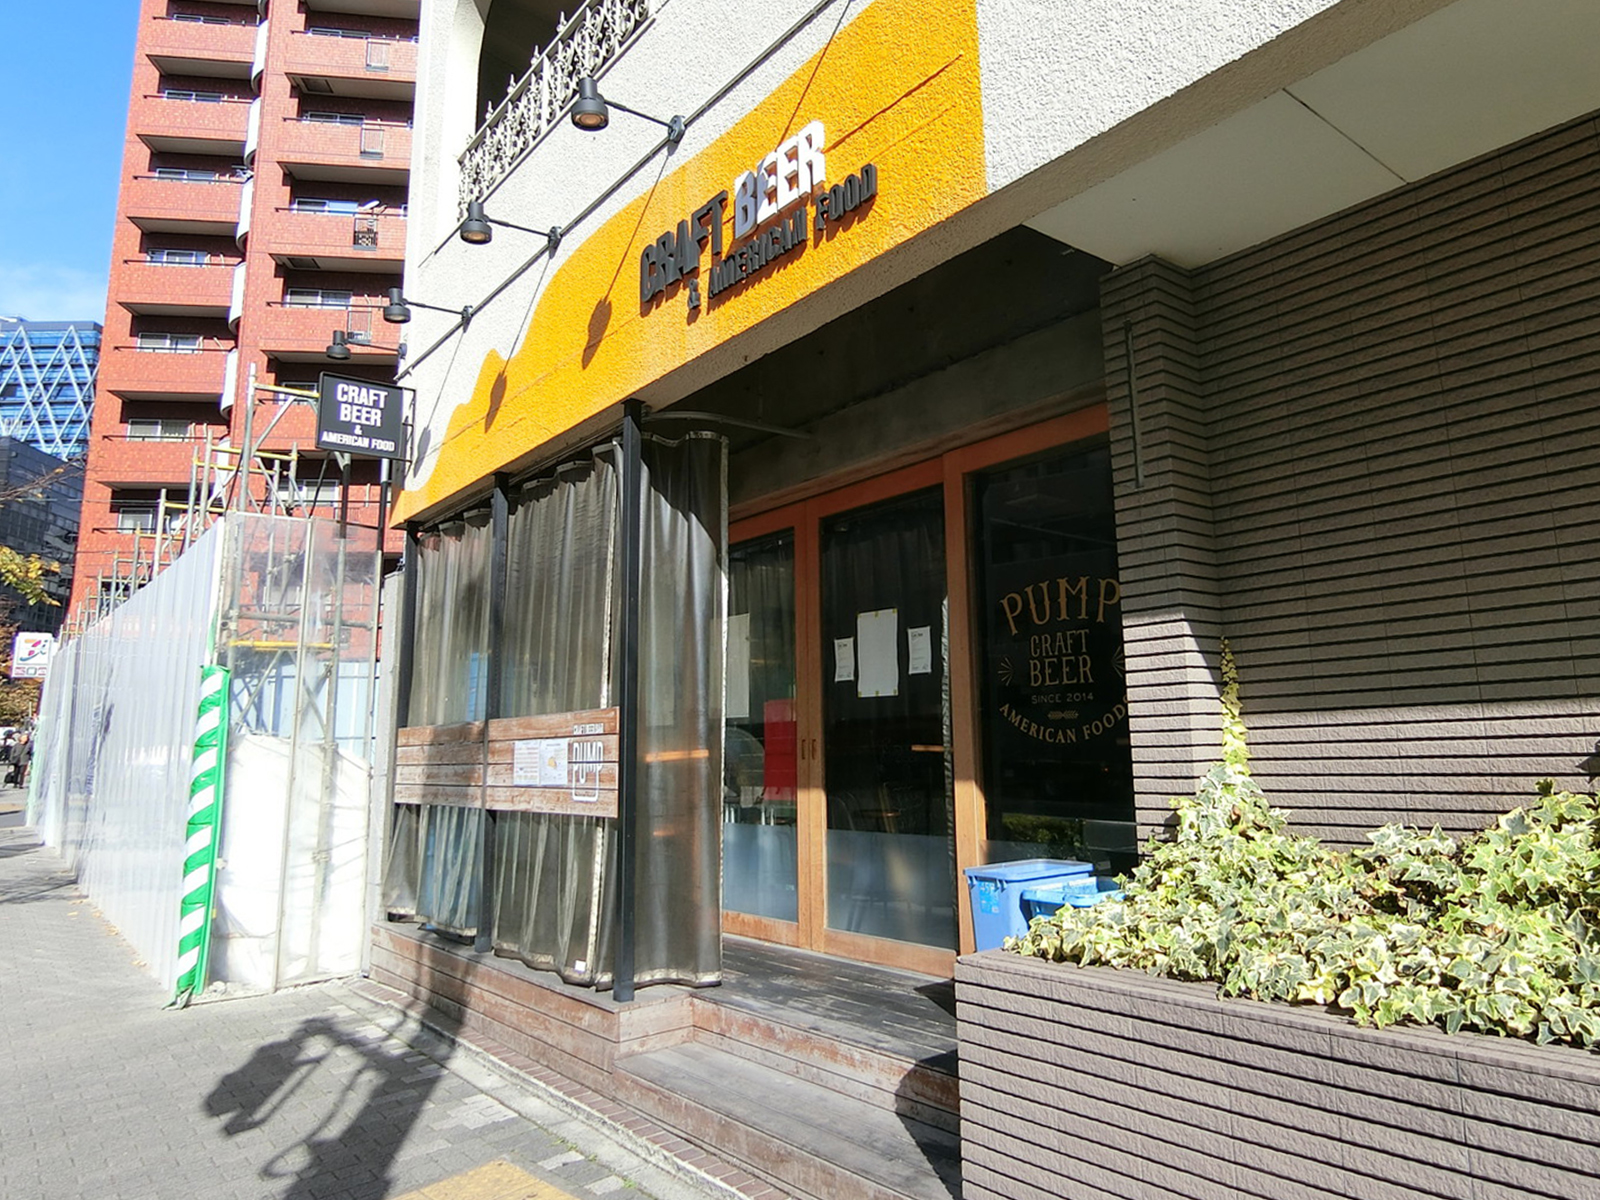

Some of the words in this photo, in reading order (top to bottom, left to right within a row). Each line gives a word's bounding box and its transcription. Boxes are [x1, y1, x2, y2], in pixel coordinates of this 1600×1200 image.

[640, 190, 729, 302] CRAFT
[735, 120, 826, 240] BEER
[687, 278, 701, 310] &
[708, 206, 808, 298] AMERICAN
[815, 163, 877, 231] FOOD
[336, 383, 388, 408] CRAFT
[340, 403, 382, 427] BEER
[321, 431, 370, 448] AMERICAN
[371, 438, 396, 451] FOOD
[354, 424, 363, 435] &
[1000, 575, 1121, 636] PUMP
[1030, 629, 1089, 657] CRAFT
[1029, 654, 1094, 687] BEER
[1031, 694, 1062, 704] SINCE
[1066, 692, 1094, 702] 2014
[999, 703, 1077, 743] AMERICAN
